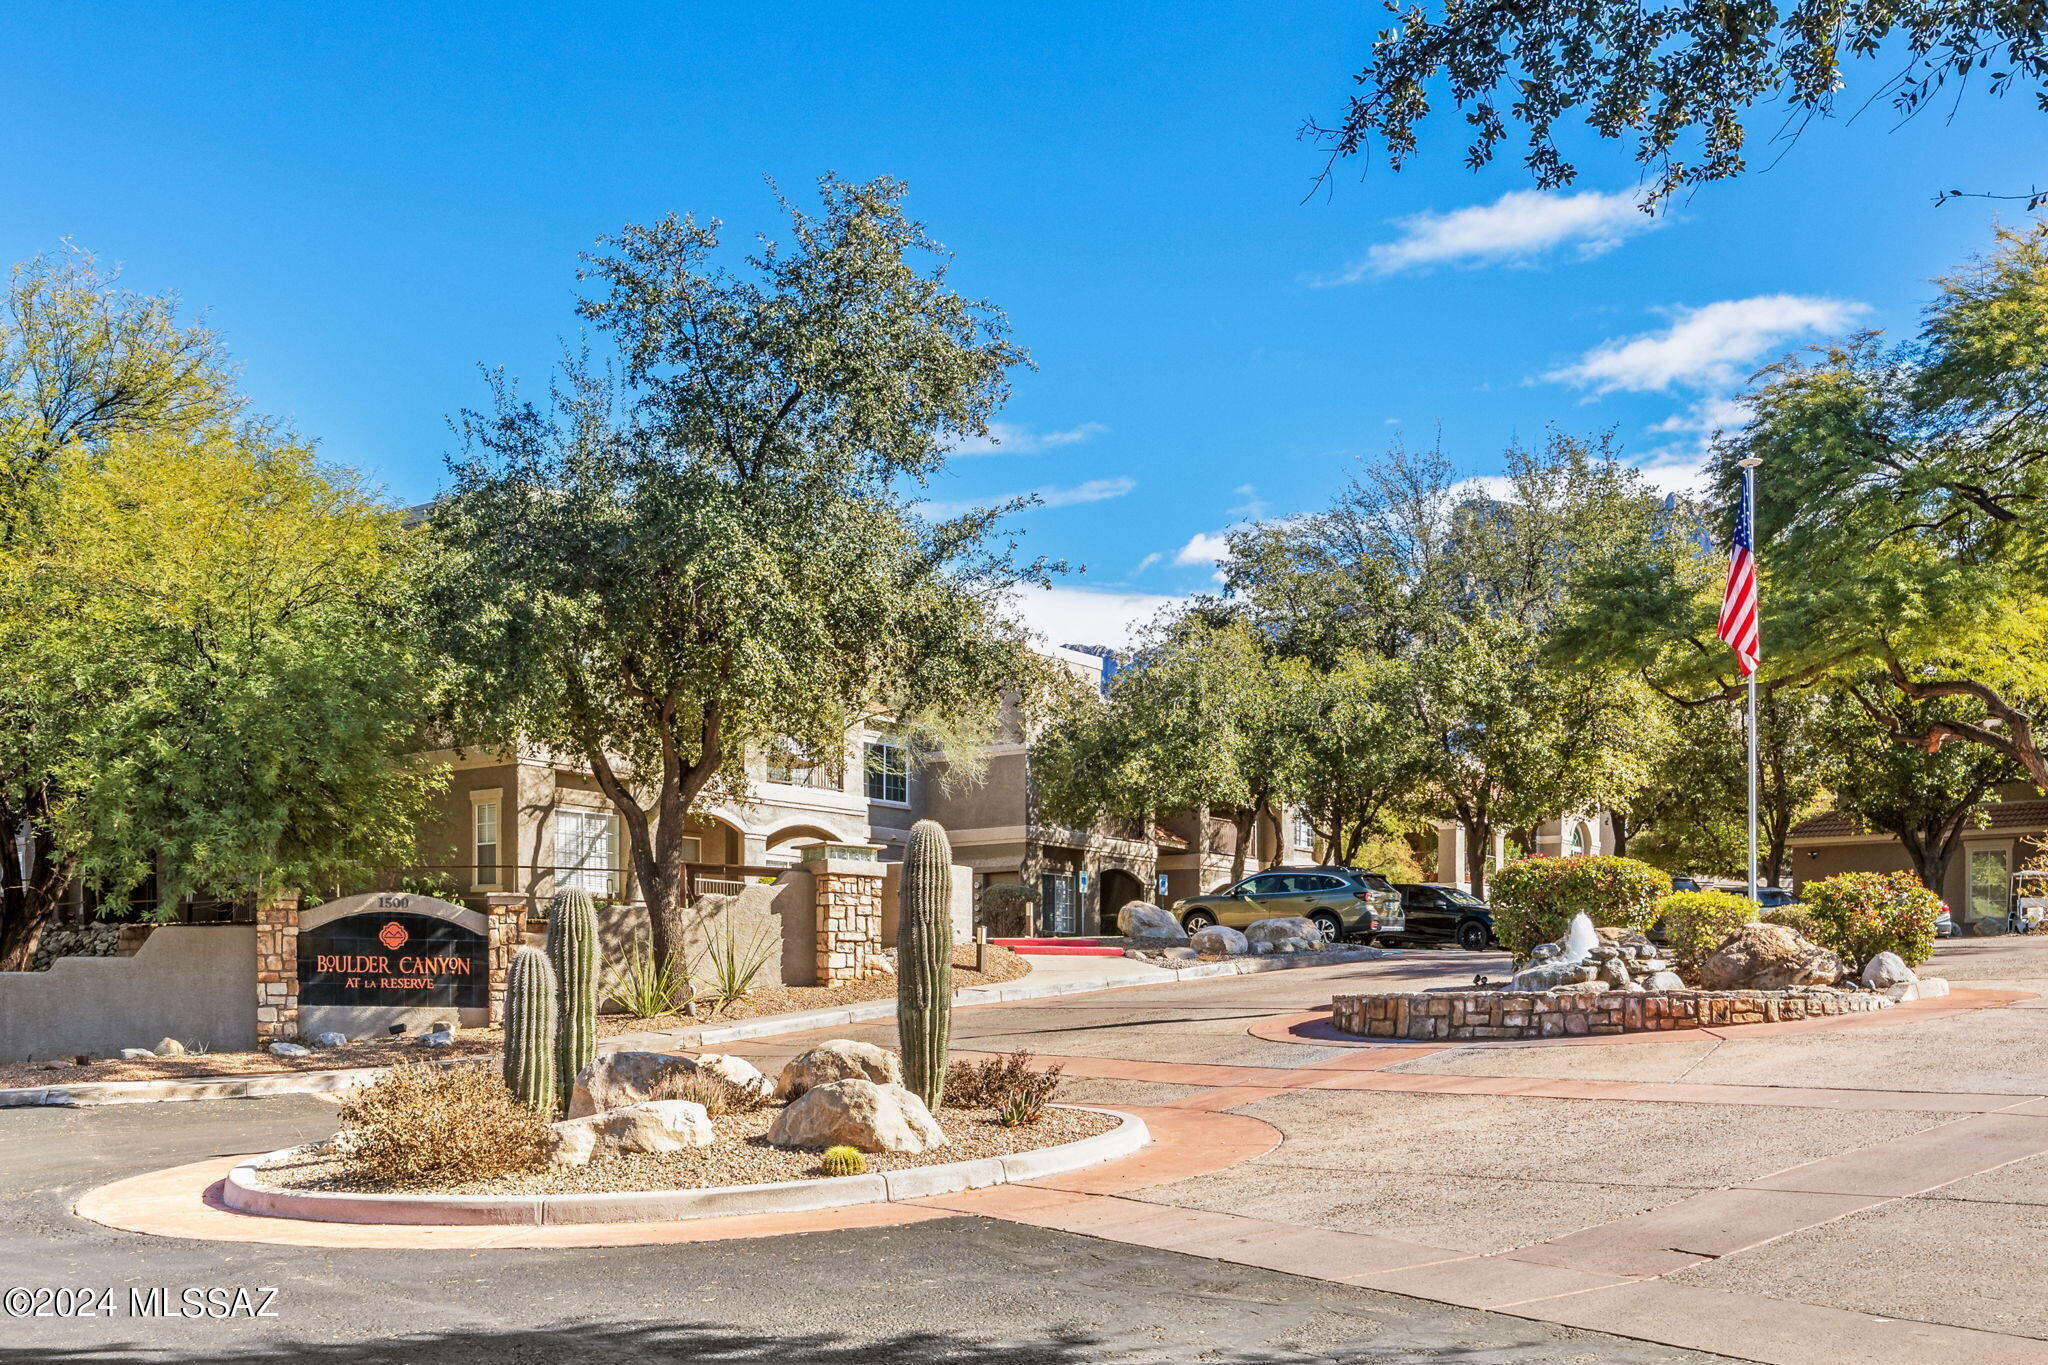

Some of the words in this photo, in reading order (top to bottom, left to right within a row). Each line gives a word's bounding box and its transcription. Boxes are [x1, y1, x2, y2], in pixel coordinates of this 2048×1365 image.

[378, 897, 409, 909] 1500
[317, 955, 391, 974] BOULDER
[400, 956, 471, 975] CANYON
[345, 978, 360, 988] AT
[364, 980, 376, 988] LA
[381, 978, 435, 989] RESERVE
